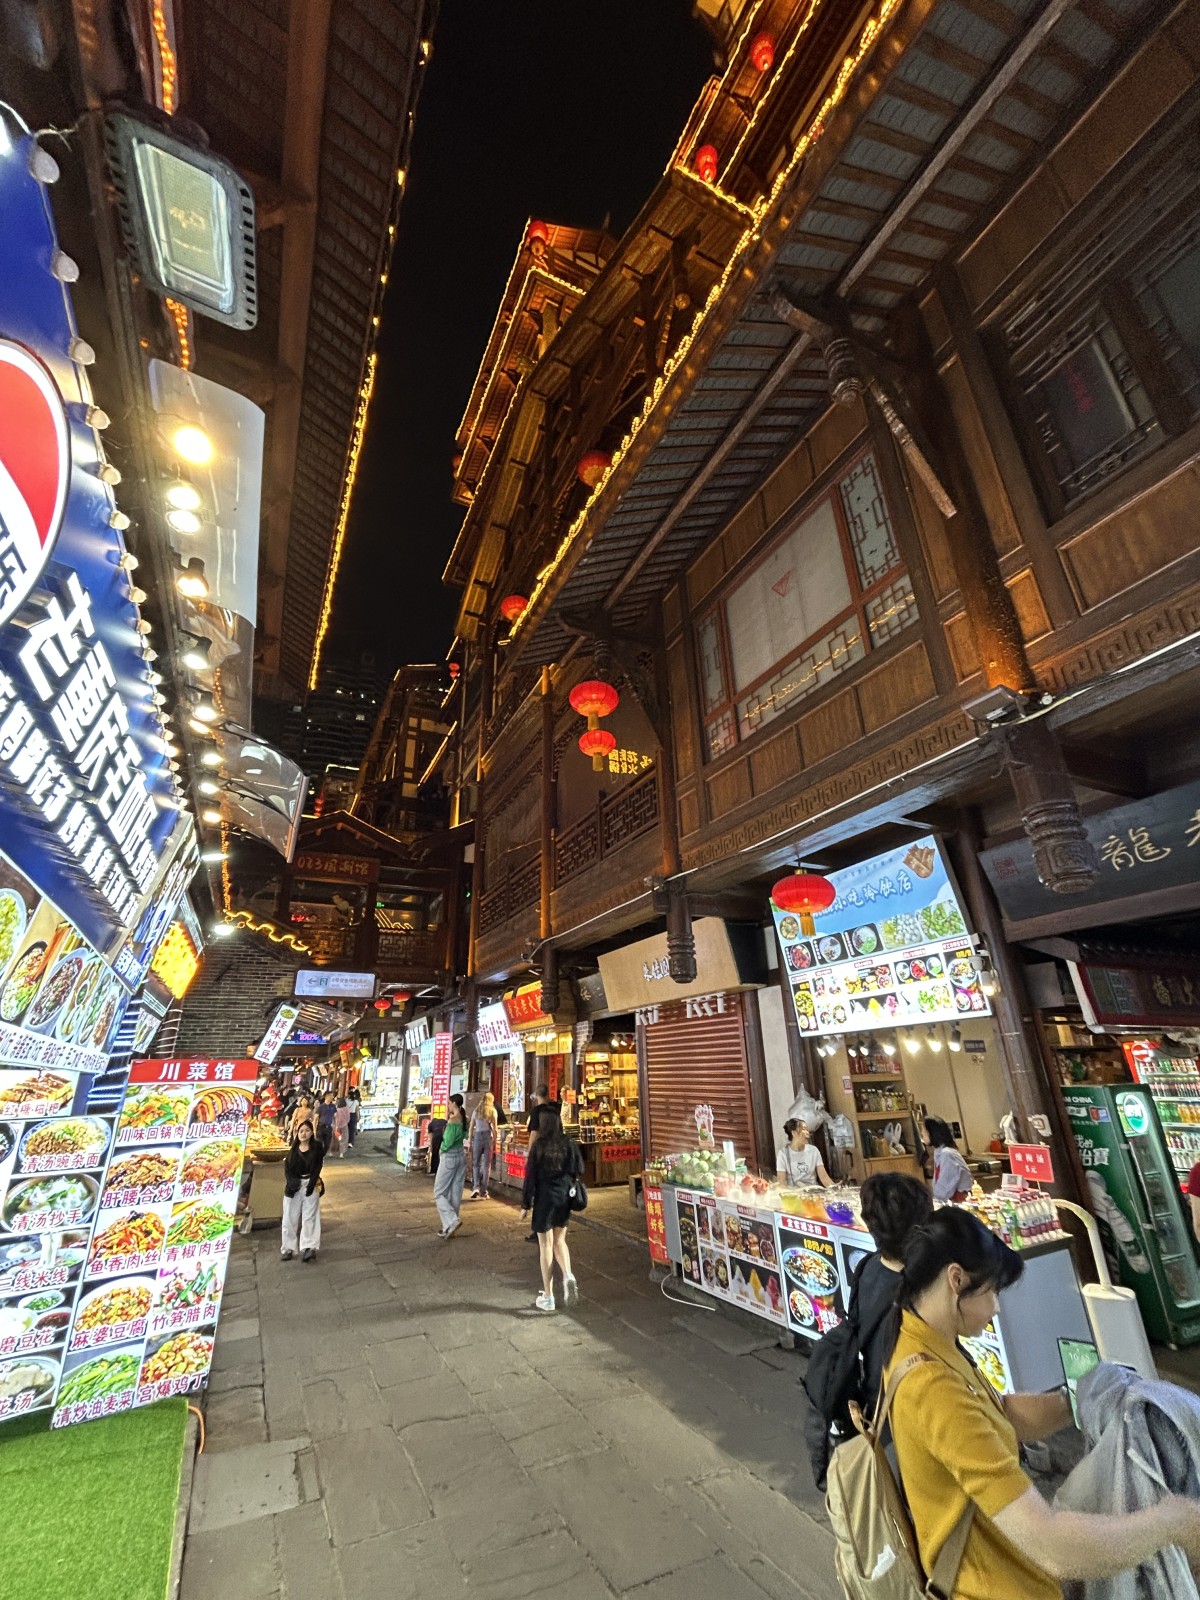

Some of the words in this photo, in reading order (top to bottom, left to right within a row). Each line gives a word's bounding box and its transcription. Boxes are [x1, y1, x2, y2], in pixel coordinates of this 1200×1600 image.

[258, 1019, 288, 1061] 怪味胡豆
[158, 1063, 235, 1081] 川菜馆
[119, 1126, 184, 1142] 川味回锅肉
[189, 1122, 247, 1137] 川味烧白
[104, 1186, 172, 1207] 肝腰合炒
[182, 1180, 235, 1197] 粉蒸肉
[13, 1210, 81, 1230] 清汤抄手
[166, 1240, 227, 1261] 青椒肉丝
[88, 1251, 158, 1275] 鱼香肉丝
[153, 1304, 216, 1330] 竹笋腊肉
[71, 1319, 146, 1348] 麻婆豆腐
[139, 1373, 206, 1402] 宫爆鸡丁
[56, 1391, 133, 1427] 清炒油麦菜
